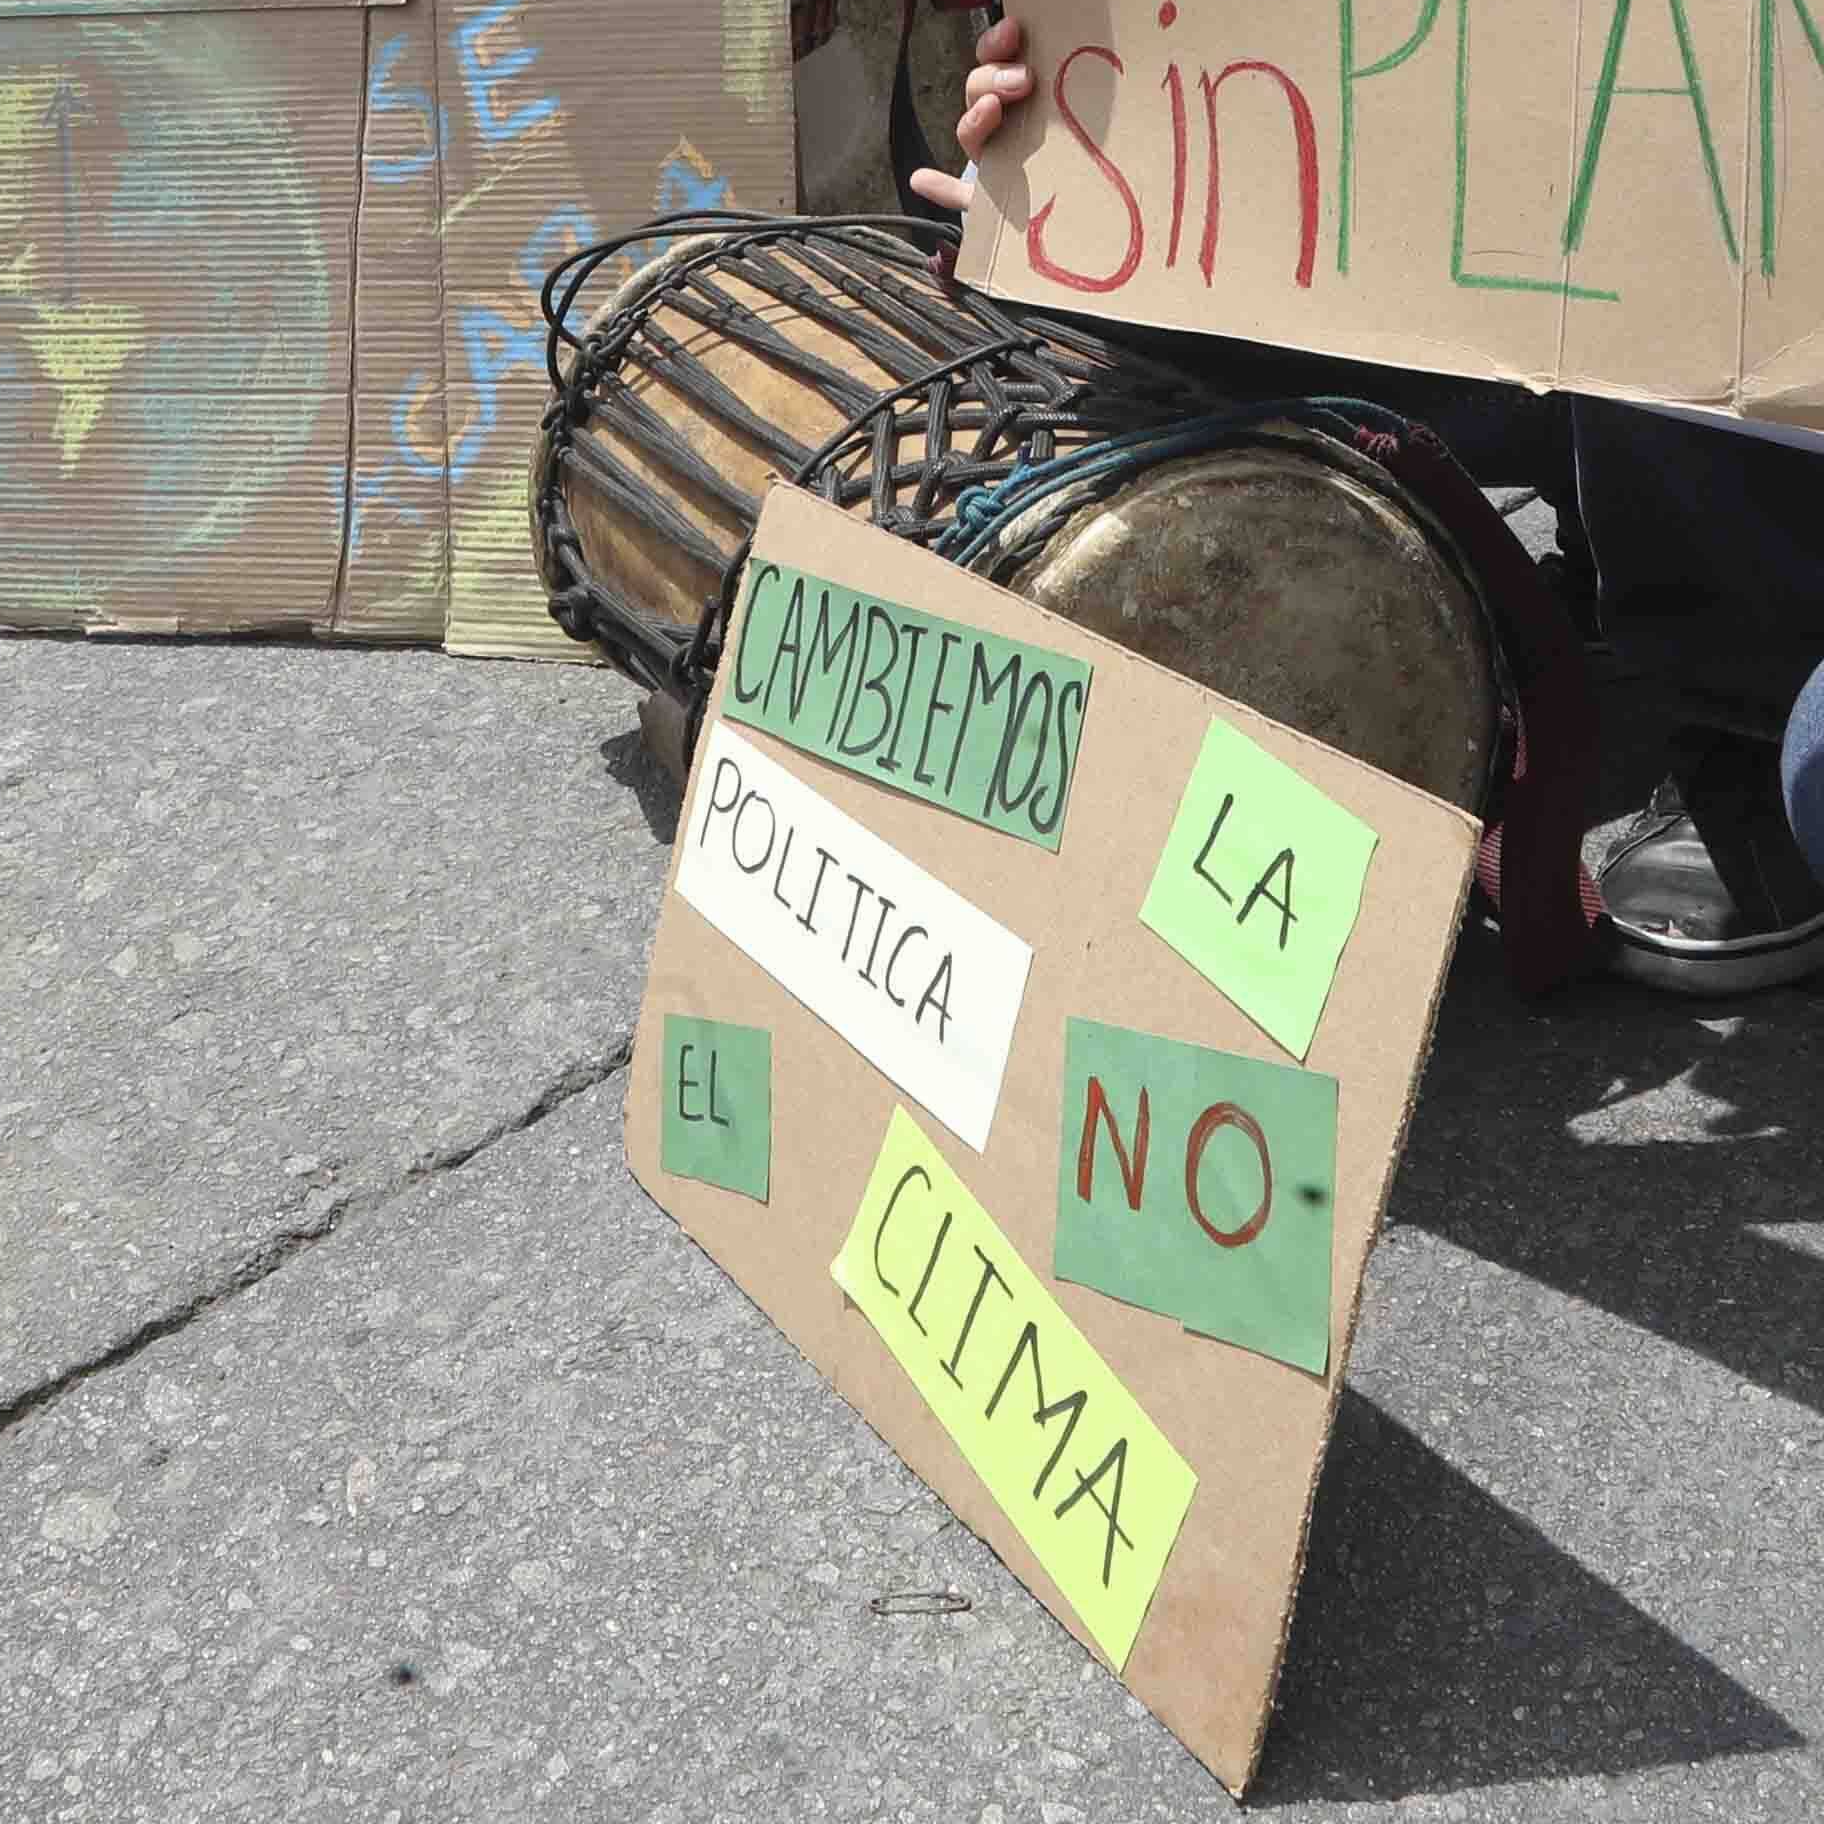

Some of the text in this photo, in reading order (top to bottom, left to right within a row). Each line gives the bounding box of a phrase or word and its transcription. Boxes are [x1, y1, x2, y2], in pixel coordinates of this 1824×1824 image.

[1026, 0, 1322, 293] sin
[733, 564, 1083, 834] CAMBIEMOS
[699, 756, 955, 1043] POLITICA
[1192, 792, 1299, 952] LA
[677, 1043, 731, 1128] EL
[1076, 1075, 1274, 1248] NO
[873, 1165, 1135, 1590] CLIMA
